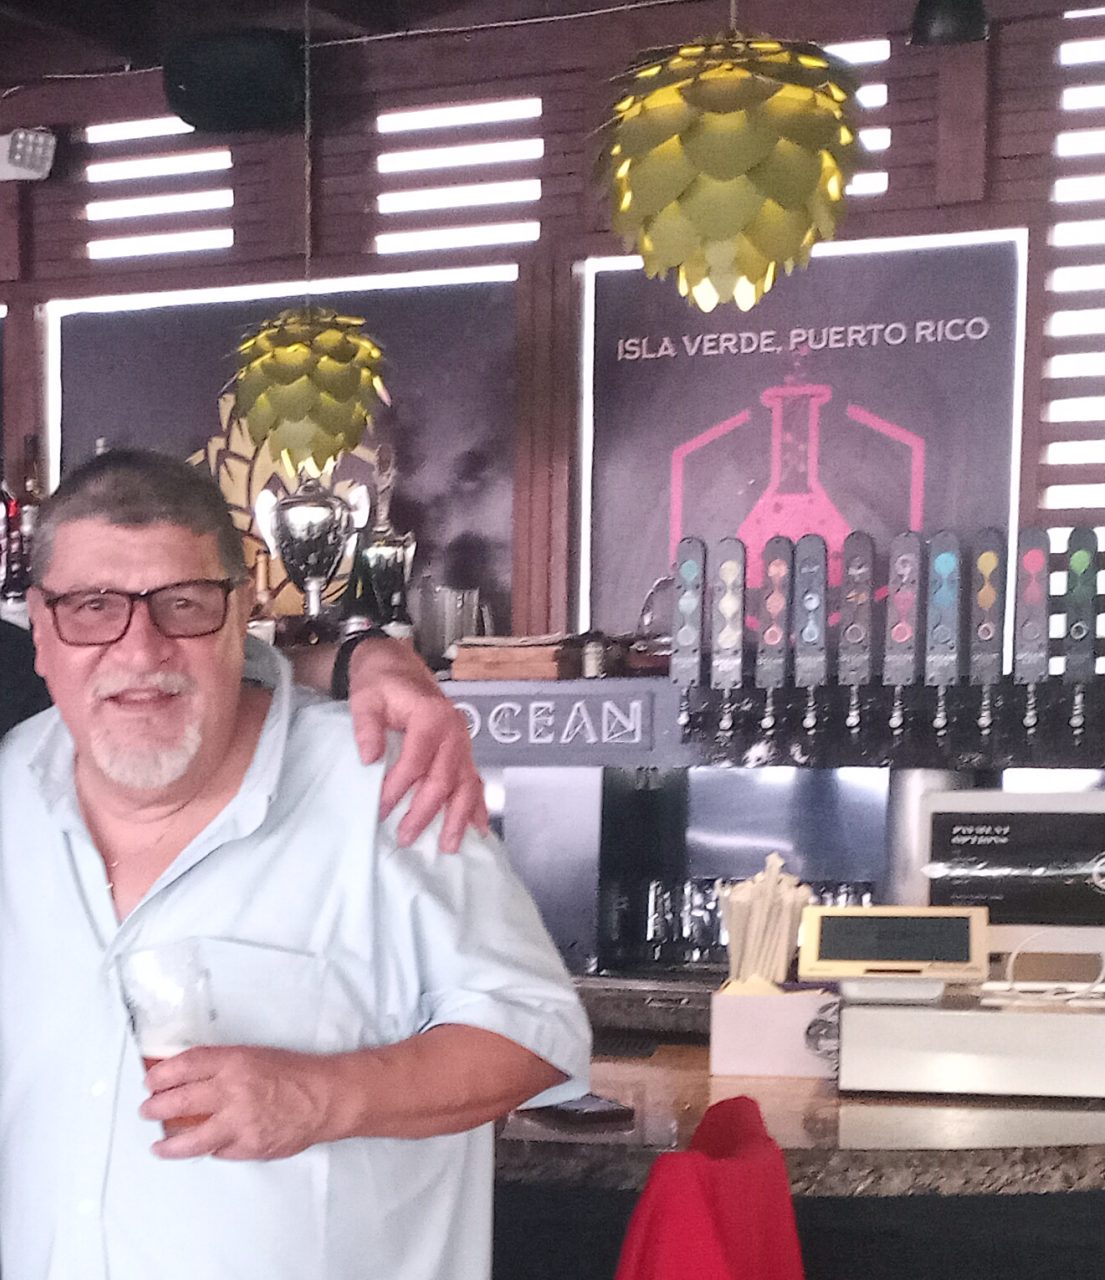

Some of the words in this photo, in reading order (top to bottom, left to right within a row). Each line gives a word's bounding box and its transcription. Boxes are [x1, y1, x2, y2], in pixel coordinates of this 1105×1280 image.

[616, 336, 675, 361] ISLA
[681, 330, 783, 357] VERDE,
[788, 322, 907, 351] PUERTO
[914, 316, 990, 343] RICO
